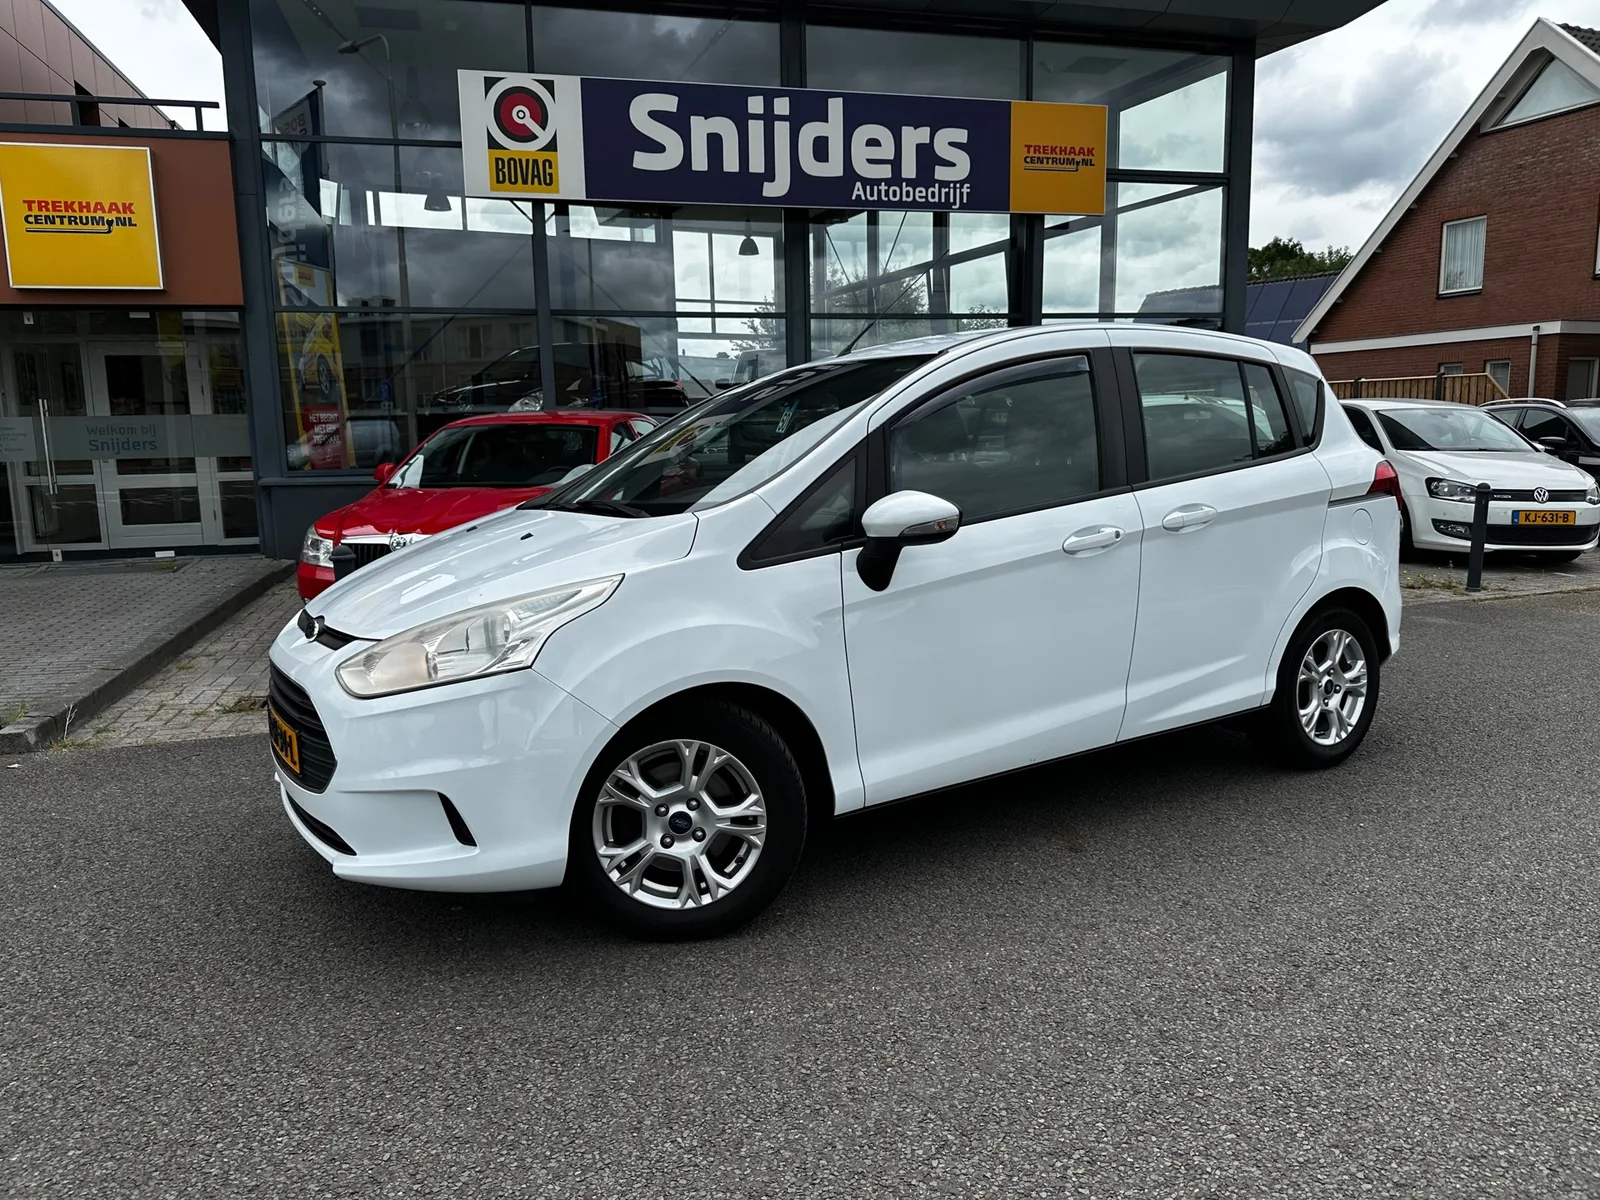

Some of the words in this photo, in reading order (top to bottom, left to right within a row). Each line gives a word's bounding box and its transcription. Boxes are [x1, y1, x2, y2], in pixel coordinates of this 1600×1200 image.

[629, 93, 971, 198] Snijders
[1024, 144, 1095, 157] TREKHAAK
[495, 157, 554, 186] BOVAG
[851, 181, 971, 209] Autobedrijf
[22, 199, 136, 215] TREKHAAK
[86, 425, 137, 436] Welkom
[141, 424, 156, 437] bij
[88, 437, 158, 455] Snijders
[1524, 512, 1570, 523] KJ-631-B
